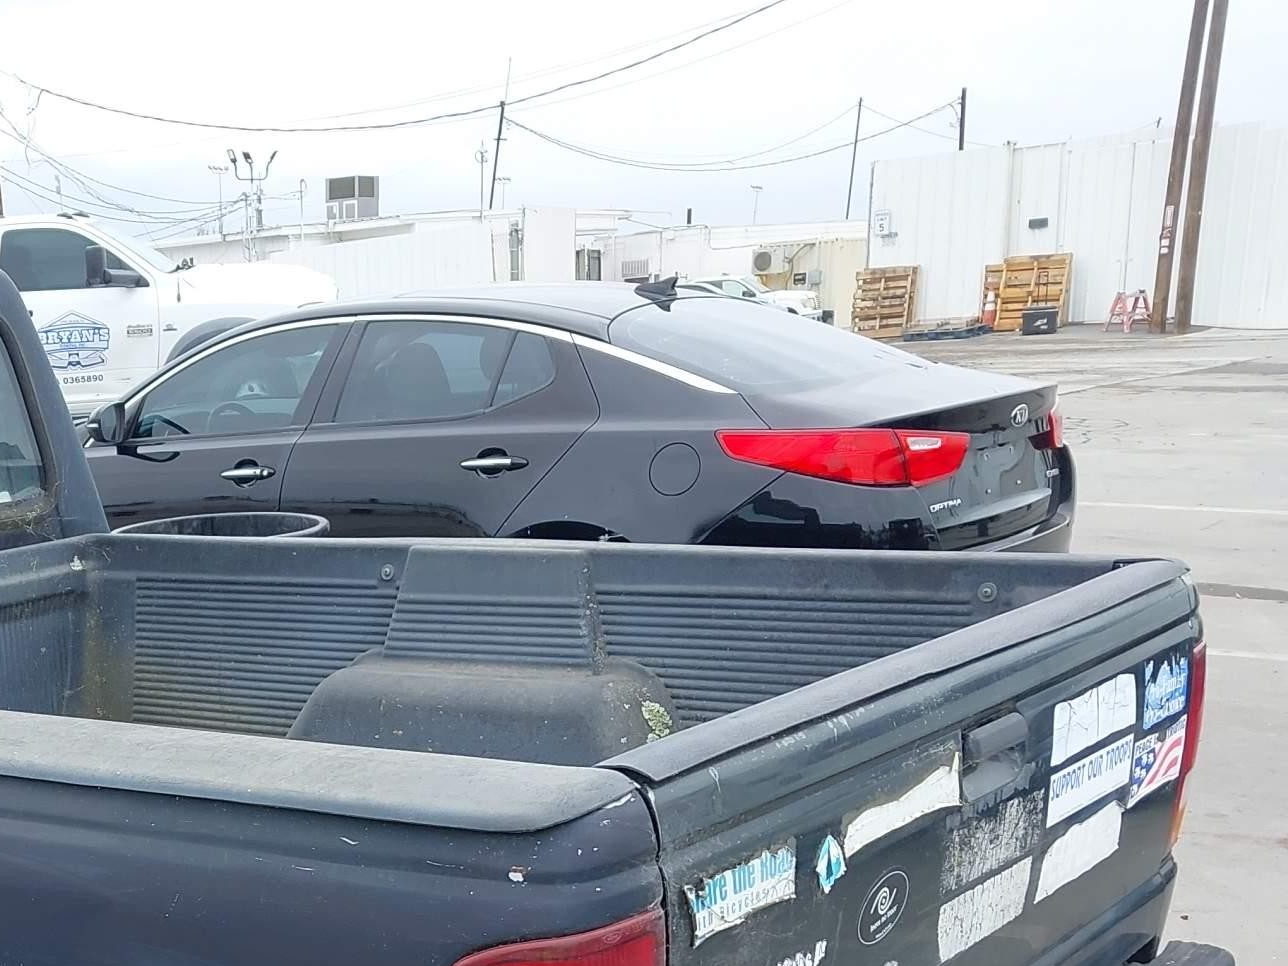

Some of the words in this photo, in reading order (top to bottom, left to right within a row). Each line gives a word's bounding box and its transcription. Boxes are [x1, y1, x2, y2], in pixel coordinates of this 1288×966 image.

[39, 328, 110, 345] BRYAN'S
[63, 374, 104, 385] 0365890
[1135, 735, 1153, 757] PEACE
[1050, 763, 1086, 801] SUPPORT
[1087, 754, 1103, 780] OUR
[1105, 738, 1132, 772] TROOPS
